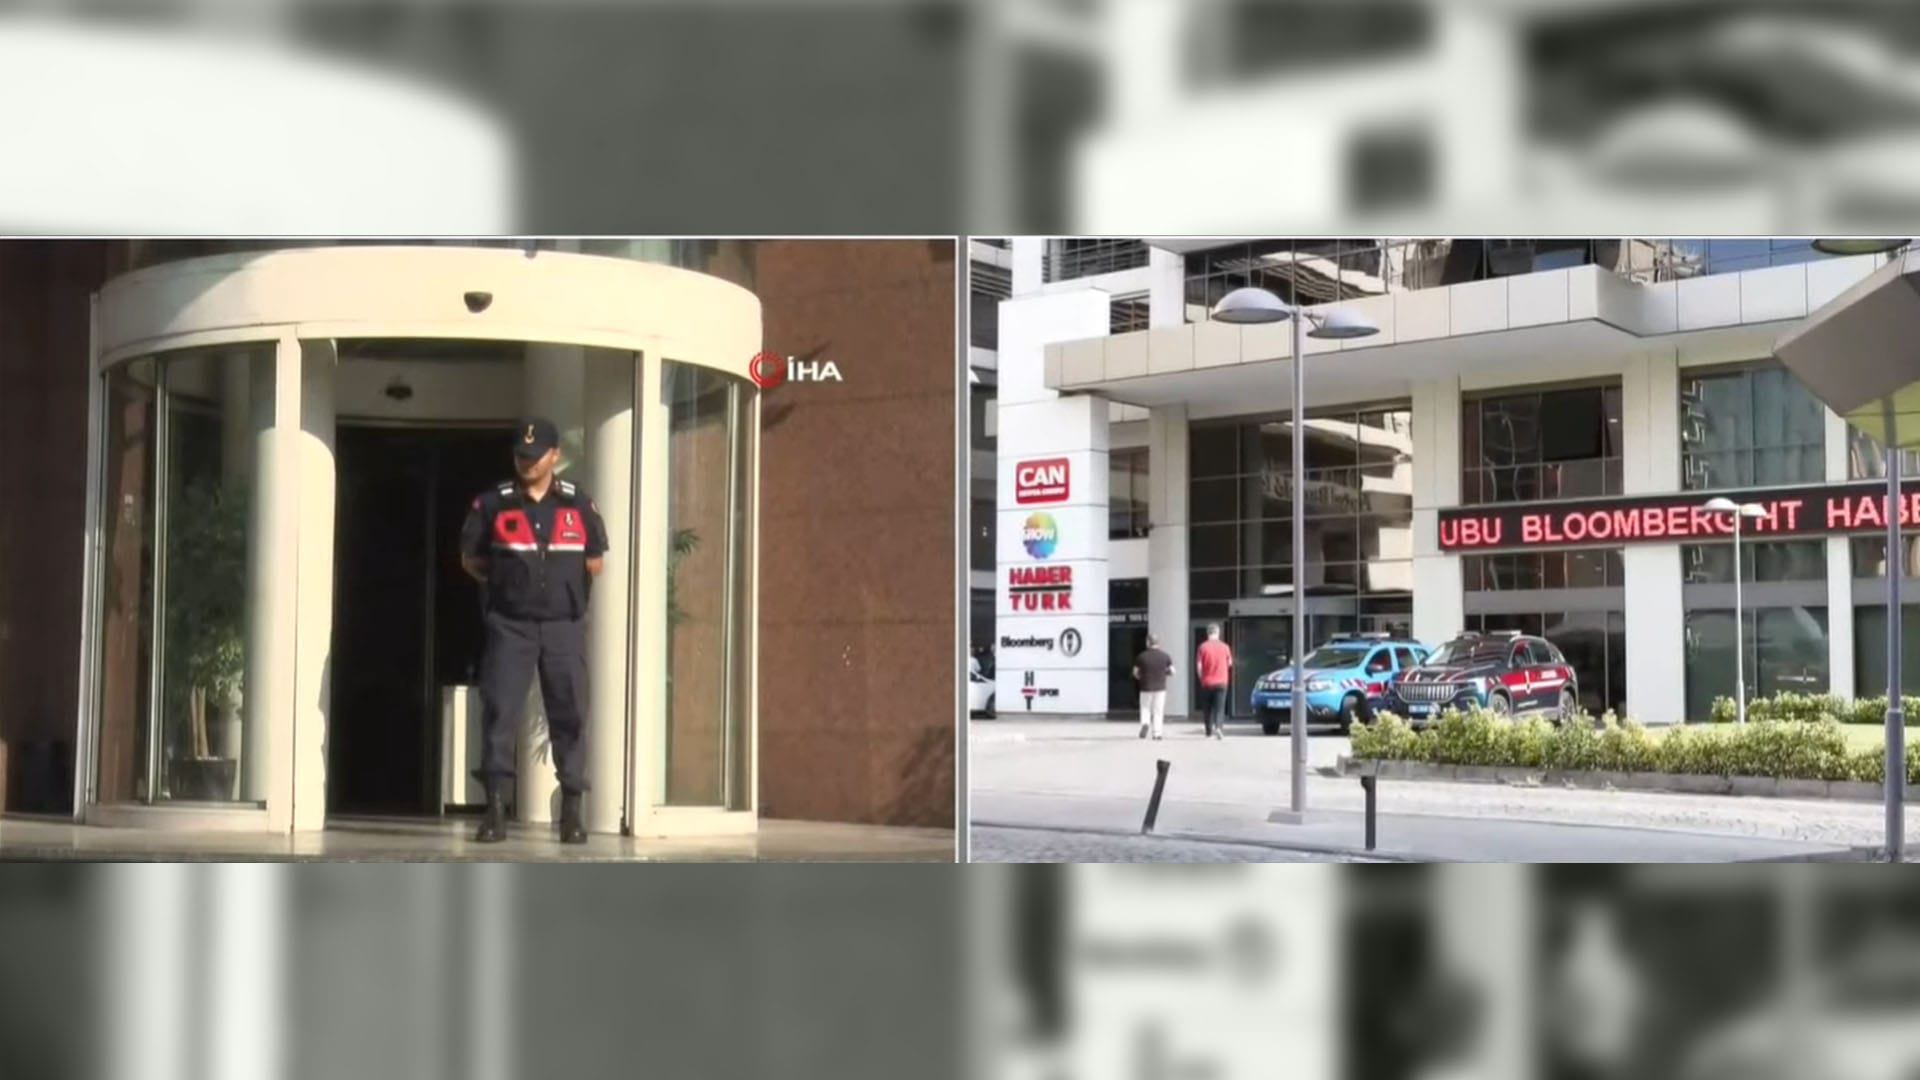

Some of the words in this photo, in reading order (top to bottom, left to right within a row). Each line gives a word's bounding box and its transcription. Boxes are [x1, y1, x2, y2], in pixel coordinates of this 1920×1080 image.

[1019, 465, 1065, 487] CAN
[1440, 518, 1501, 546] UBU
[1521, 506, 1736, 542] BLOOMBERG
[1755, 500, 1803, 531] HT
[1009, 565, 1072, 585] HABER
[1000, 635, 1054, 651] Bloomberg
